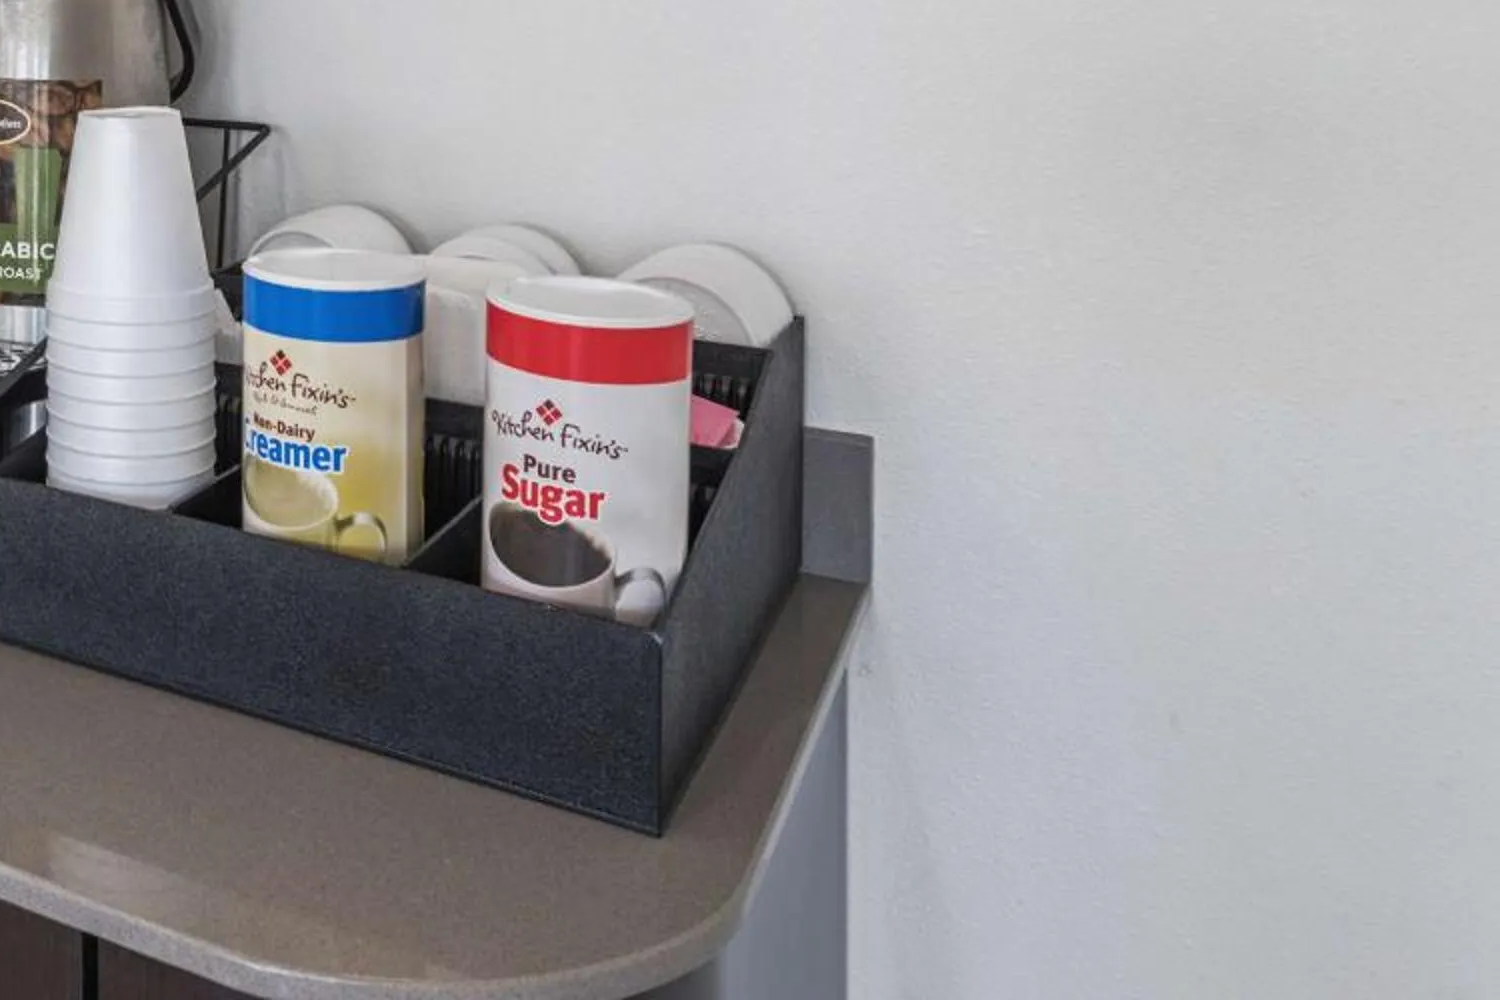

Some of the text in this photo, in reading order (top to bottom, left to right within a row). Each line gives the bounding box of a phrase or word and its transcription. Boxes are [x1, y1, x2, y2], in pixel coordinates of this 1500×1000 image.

[253, 411, 315, 442] Non-Dairy
[492, 410, 622, 460] Kitchen Fixin's
[245, 429, 347, 472] reamer
[523, 454, 576, 484] Pure
[502, 464, 605, 523] Sugar
